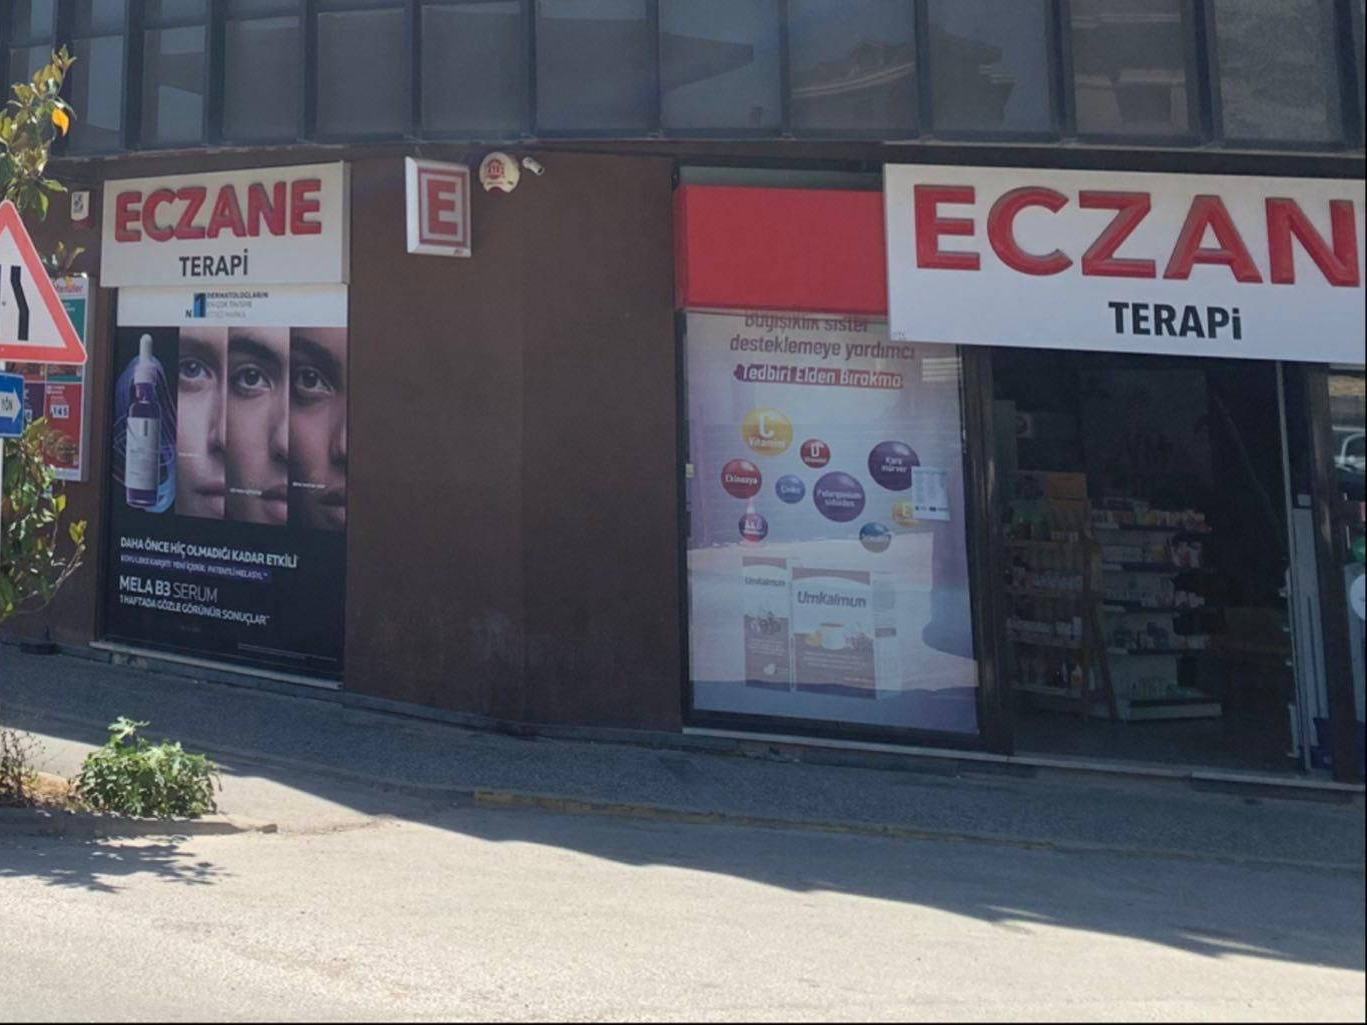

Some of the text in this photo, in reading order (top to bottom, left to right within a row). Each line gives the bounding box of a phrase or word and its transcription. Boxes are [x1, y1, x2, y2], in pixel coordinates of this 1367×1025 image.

[114, 177, 322, 243] ECZANE
[426, 178, 459, 237] E
[912, 183, 1361, 288] ECZAN
[178, 248, 249, 278] TERAPİ
[730, 333, 915, 361] desteklemeye yardımcı
[743, 364, 792, 382] Tedbiri
[795, 367, 835, 384] Elden
[1, 395, 13, 411] YÖN
[121, 536, 144, 550] DAHA
[144, 537, 170, 553] ÖNCE
[170, 540, 186, 559] HİÇ
[186, 544, 231, 561] OLMADIĞI
[231, 549, 265, 565] KADAR
[119, 575, 218, 603] MELA B3 SERUM
[797, 590, 866, 608] Umkalmun
[156, 599, 181, 612] GÖZLE
